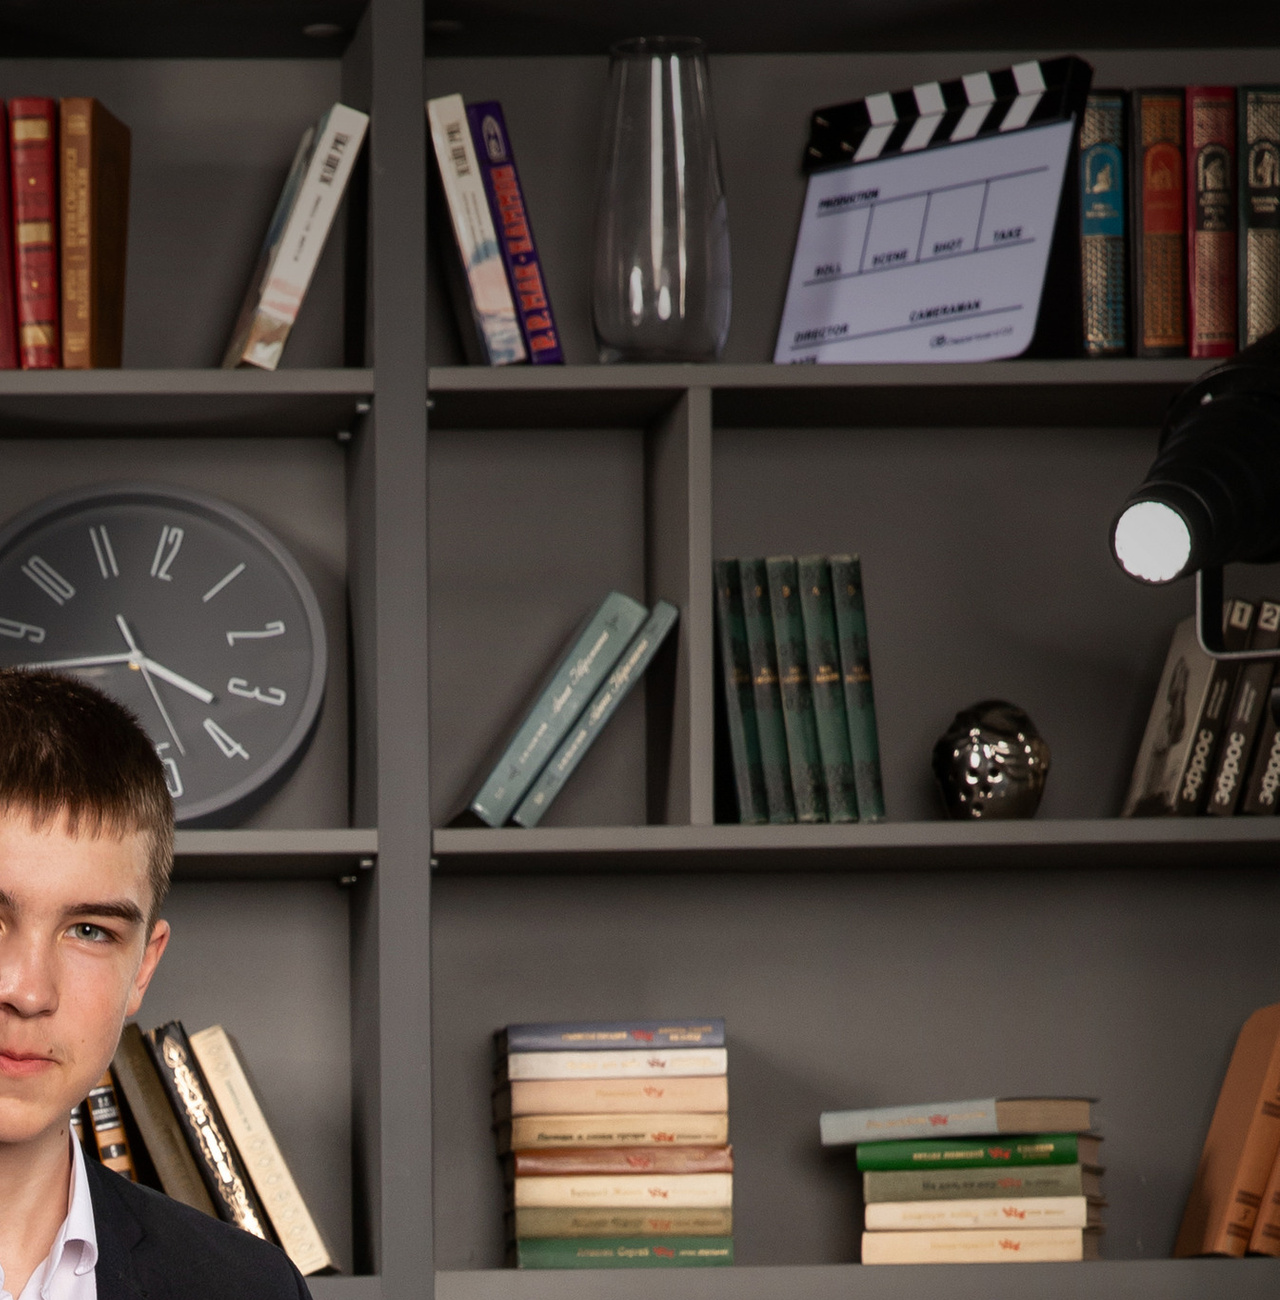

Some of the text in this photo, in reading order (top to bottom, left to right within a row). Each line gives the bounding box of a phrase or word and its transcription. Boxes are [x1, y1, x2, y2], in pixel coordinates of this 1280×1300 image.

[816, 188, 880, 208] PRODUCTION
[992, 226, 1023, 242] TAKE
[932, 238, 963, 254] SHOT
[872, 250, 909, 267] SCENE
[908, 299, 981, 321] CAMERAMAN
[793, 323, 849, 342] DIRECTOR
[150, 525, 185, 581] 12
[20, 555, 77, 605] 10
[226, 621, 286, 646] 2
[227, 677, 287, 706] 3
[202, 717, 250, 760] 4
